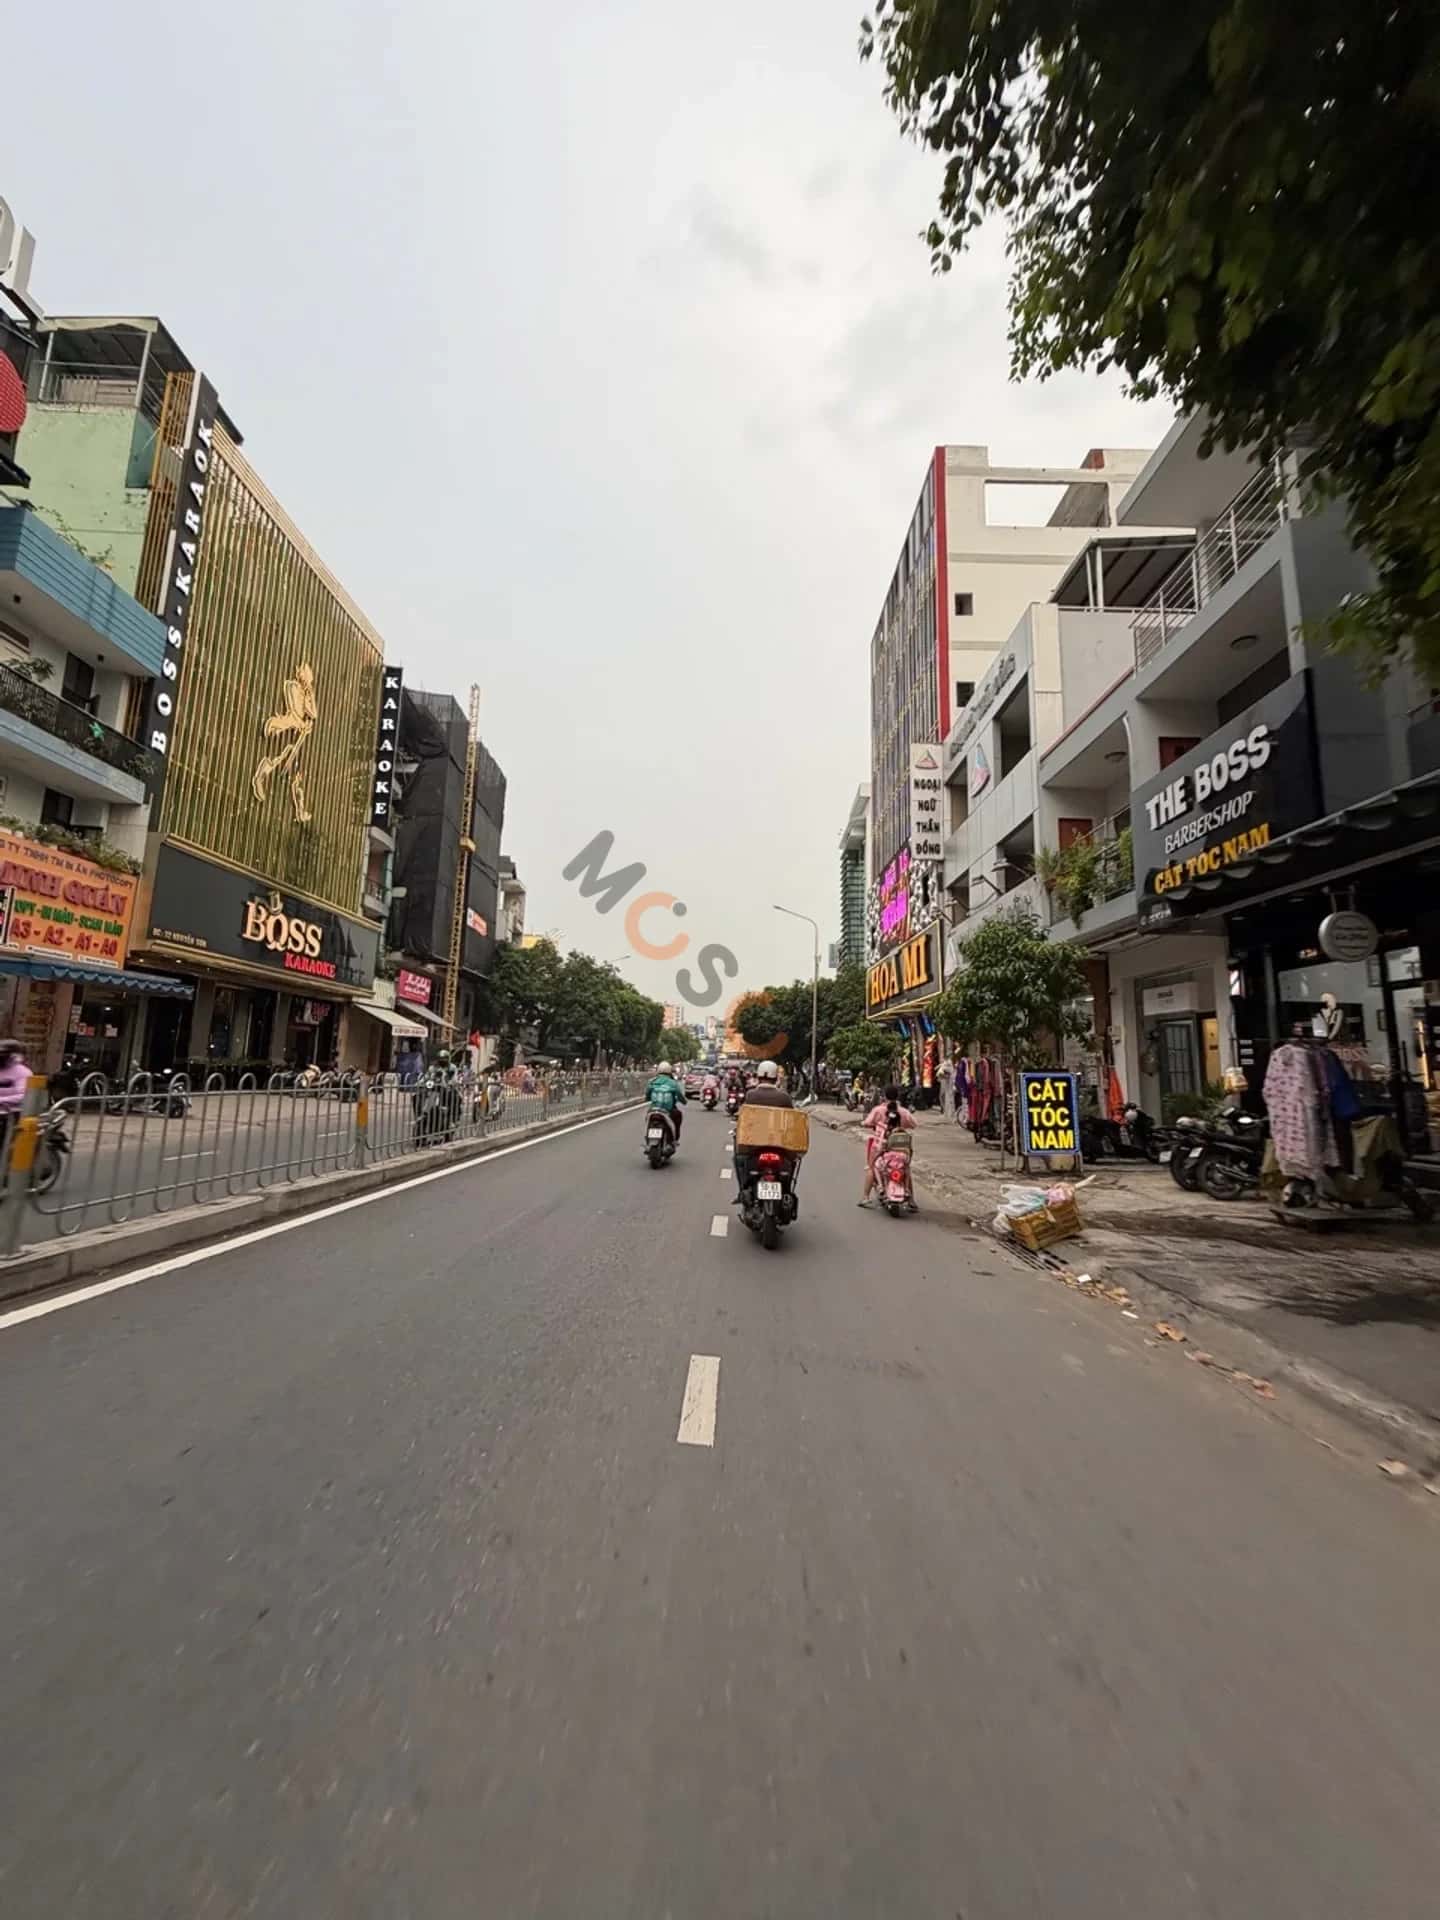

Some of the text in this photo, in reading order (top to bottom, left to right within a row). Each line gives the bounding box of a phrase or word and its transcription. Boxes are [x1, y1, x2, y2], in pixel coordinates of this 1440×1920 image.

[374, 676, 399, 815] KARAOKE
[1145, 724, 1271, 831] THE BOSS
[1164, 791, 1255, 854] BARBERSHOP
[8, 841, 21, 854] TY
[1222, 822, 1271, 865] NAM
[43, 925, 65, 946] A2
[242, 901, 322, 958] BOSS
[284, 952, 336, 978] KARAOKE
[1028, 1102, 1070, 1127] TÓC
[1030, 1130, 1074, 1149] NAM
